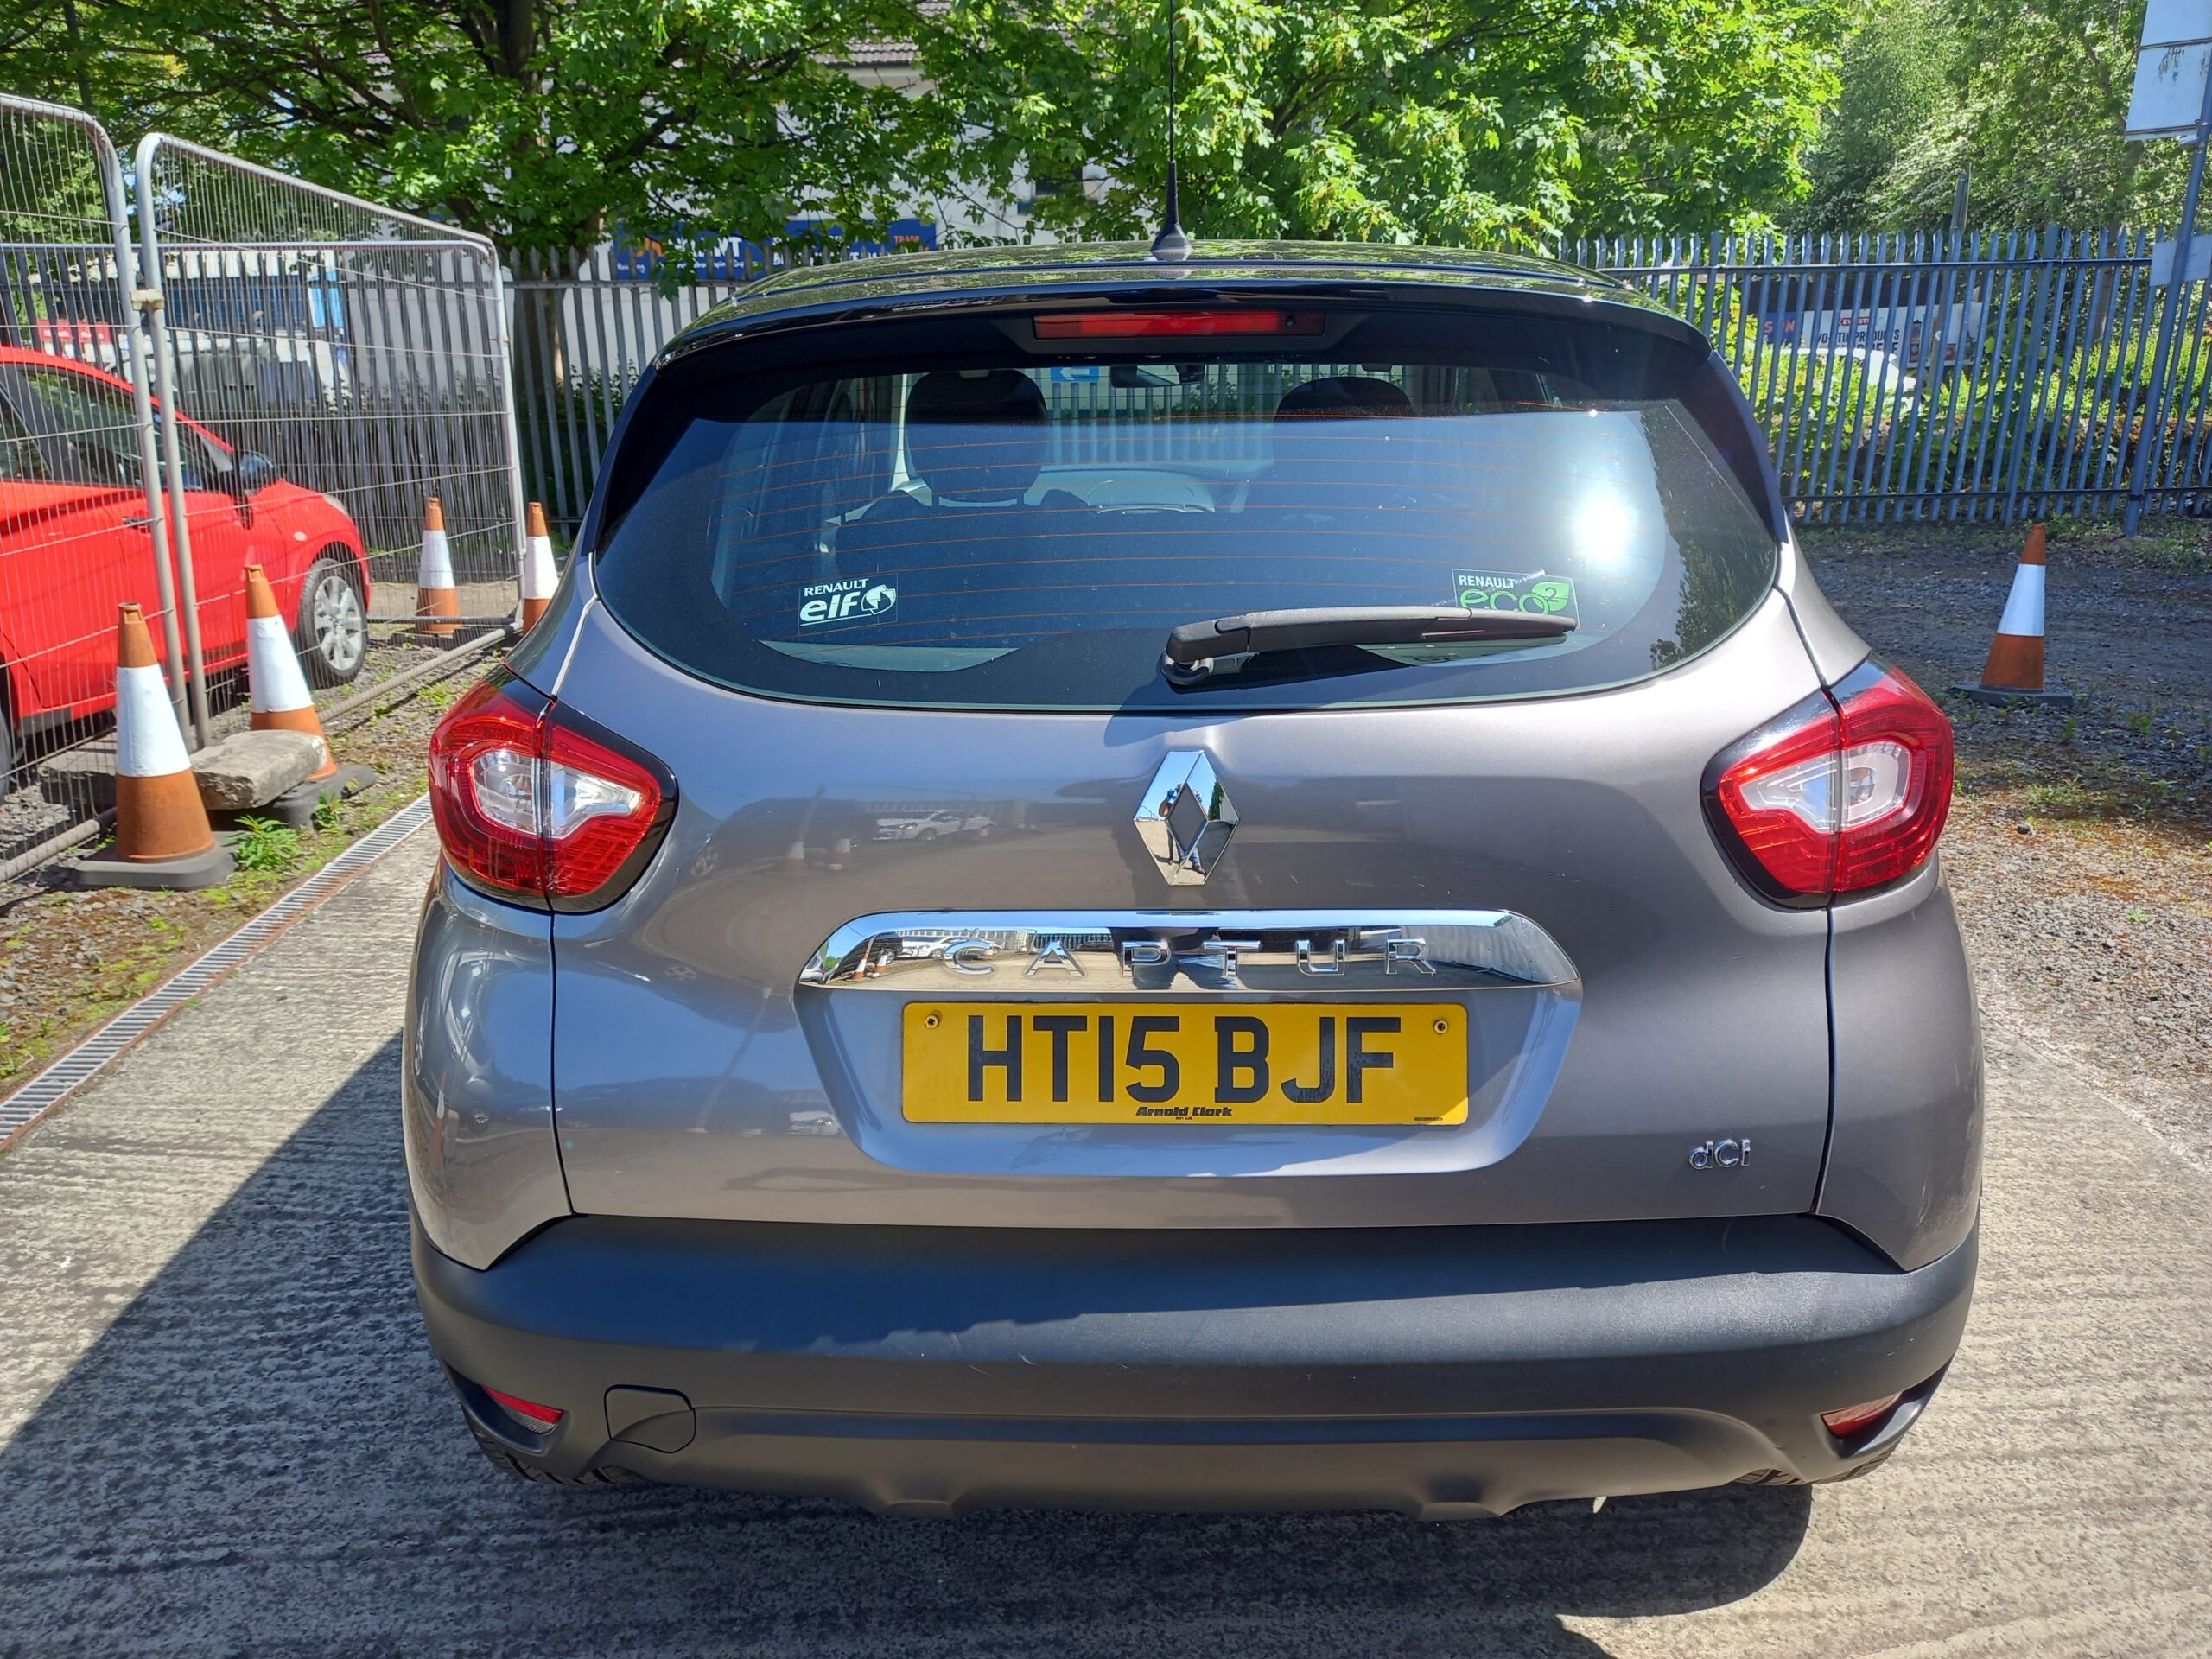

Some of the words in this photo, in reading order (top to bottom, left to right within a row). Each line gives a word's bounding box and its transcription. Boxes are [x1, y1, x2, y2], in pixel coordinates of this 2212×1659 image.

[804, 578, 869, 597] RENAULT
[1459, 575, 1515, 588] RENAULT
[799, 591, 861, 622] elf
[944, 938, 1436, 977] CAPTUR
[968, 1014, 1180, 1103] HT15
[1214, 1015, 1402, 1103] BJF
[1135, 1106, 1190, 1117] Arnold
[1192, 1106, 1233, 1117] Clark
